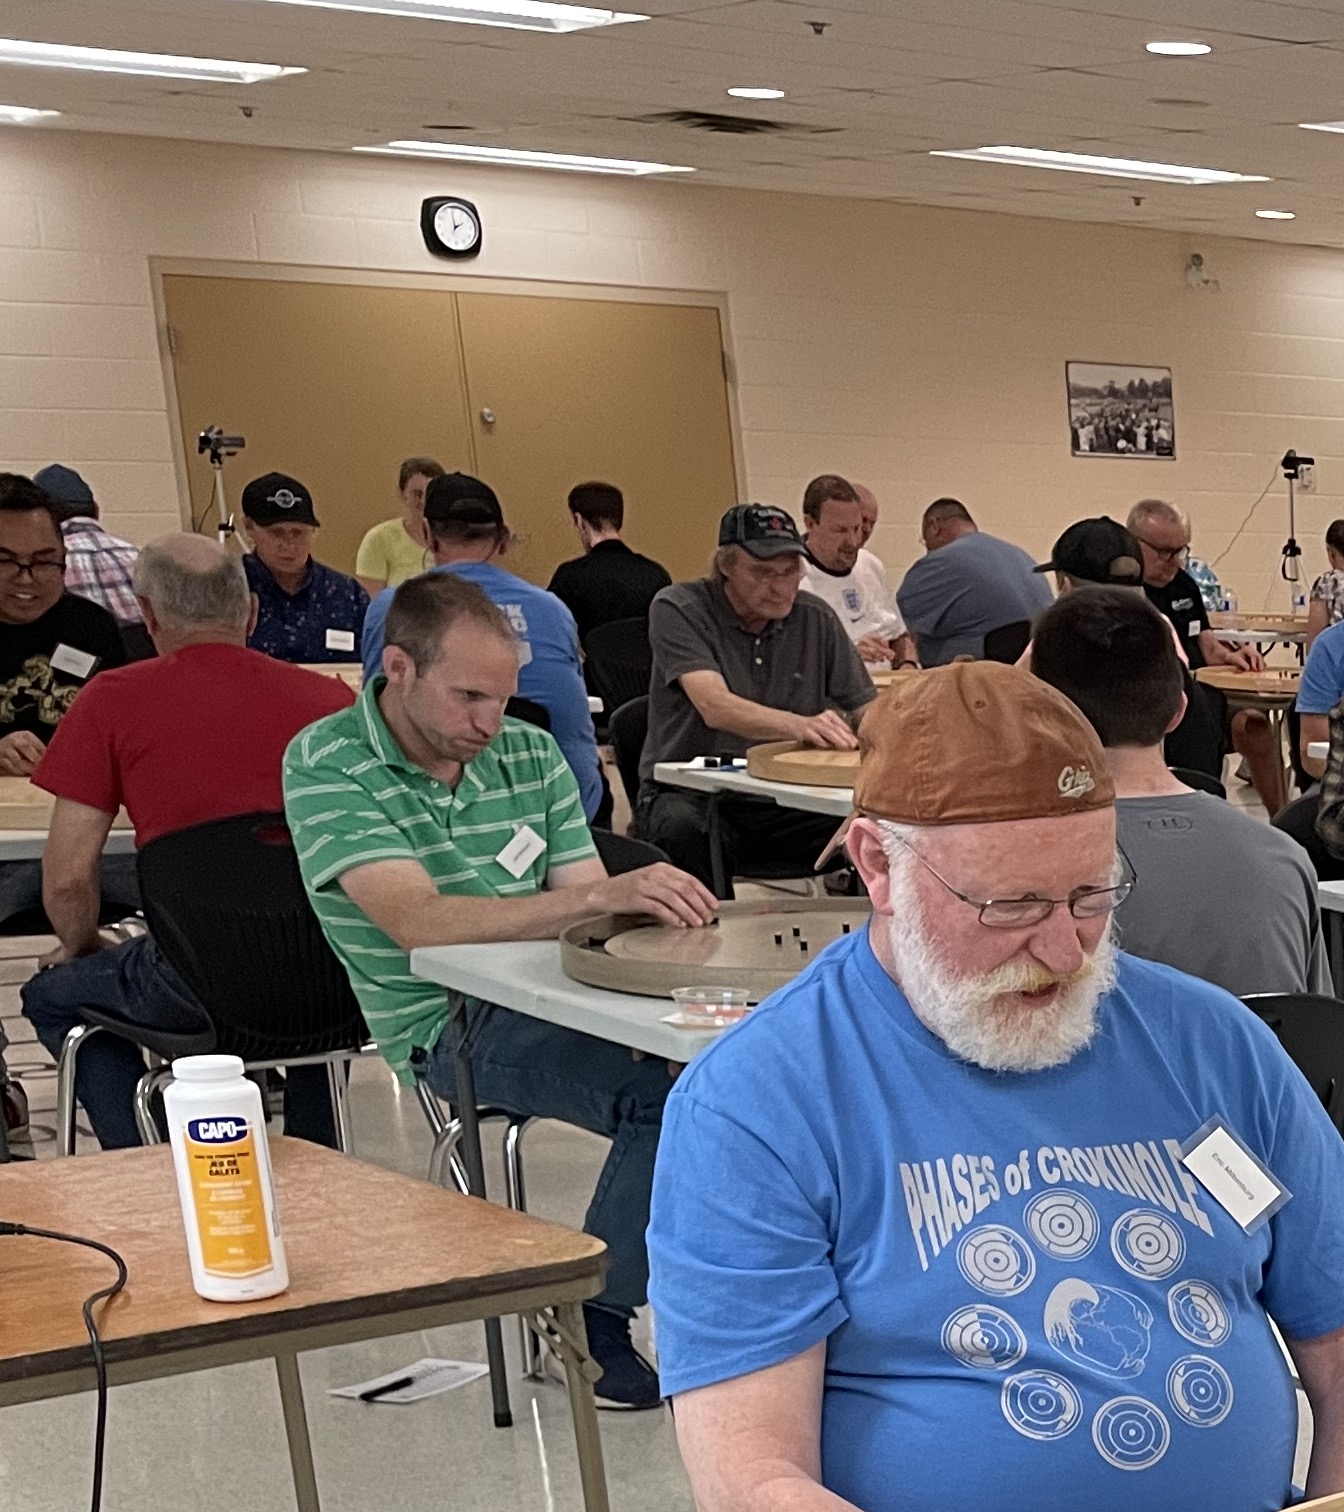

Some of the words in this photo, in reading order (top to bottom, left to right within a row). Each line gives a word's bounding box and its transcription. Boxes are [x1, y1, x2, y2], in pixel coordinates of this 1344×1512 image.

[198, 1121, 237, 1140] CAPO
[899, 1153, 1000, 1272] PHASES
[1004, 1150, 1032, 1196] of
[1037, 1138, 1215, 1238] CROKINOLE
